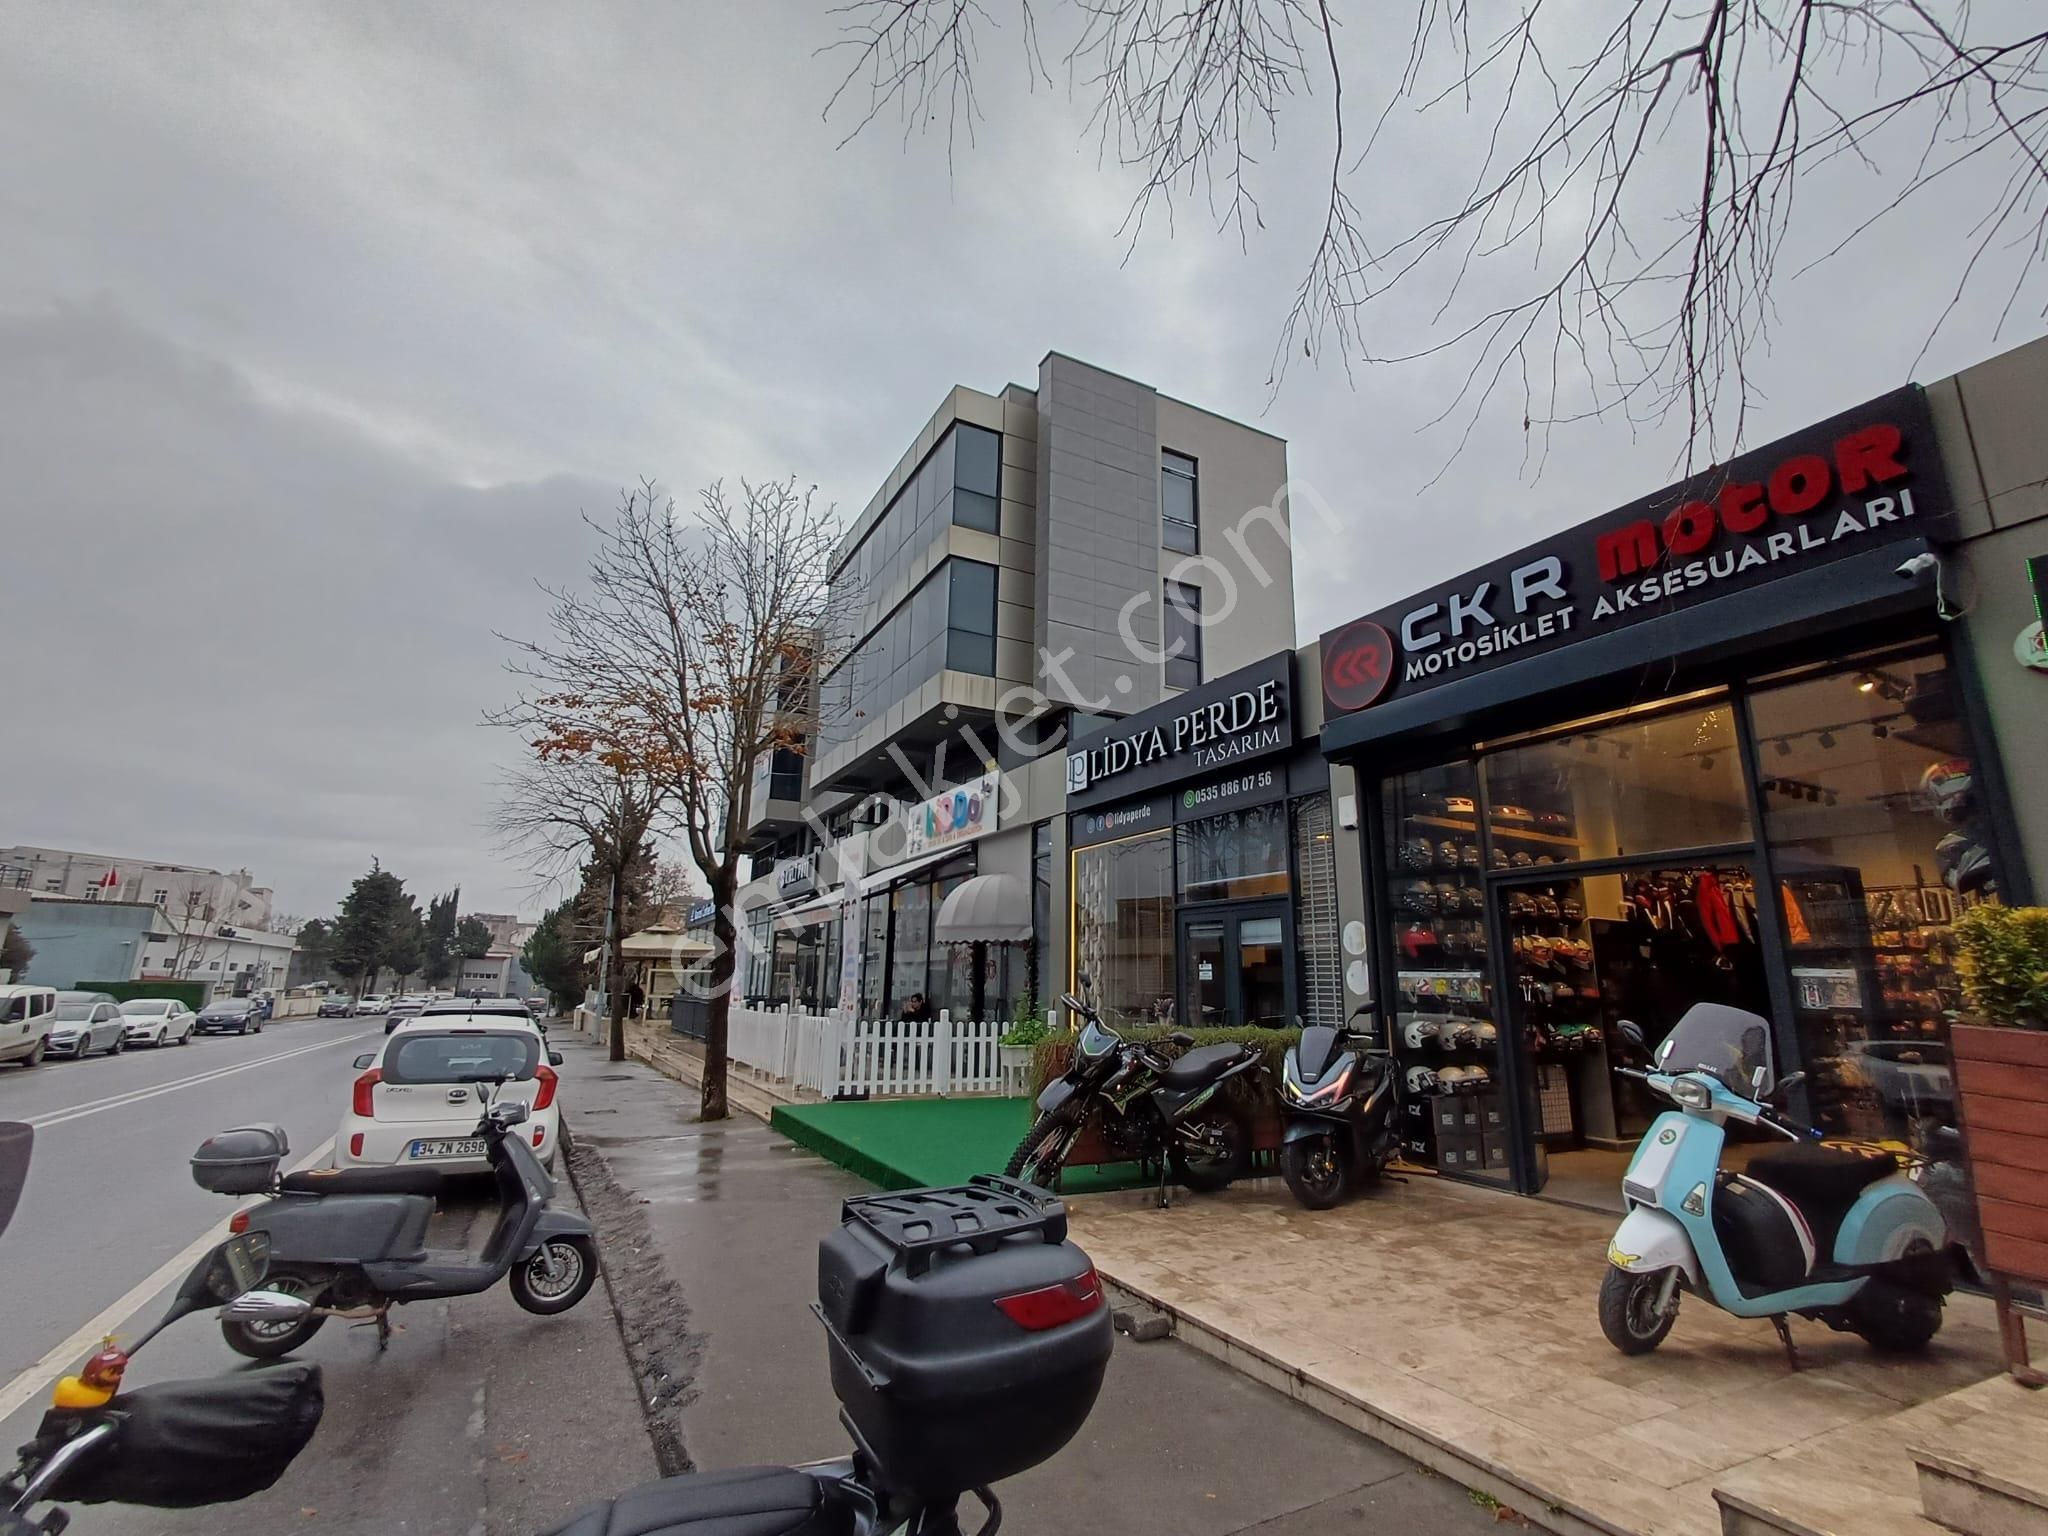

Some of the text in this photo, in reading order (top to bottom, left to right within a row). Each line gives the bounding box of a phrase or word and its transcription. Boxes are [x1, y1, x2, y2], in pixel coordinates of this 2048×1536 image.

[1402, 556, 1567, 652] CKR
[1405, 488, 1916, 681] MOTOSİKLET AKSESUARLARI
[1090, 679, 1278, 781] LİDYA PERDE
[1193, 726, 1280, 768] TASARIM
[1195, 770, 1272, 804] 0535 886 07 56
[1114, 804, 1151, 825] lidyaperde
[420, 1143, 434, 1155] 34
[438, 1142, 453, 1154] ZN
